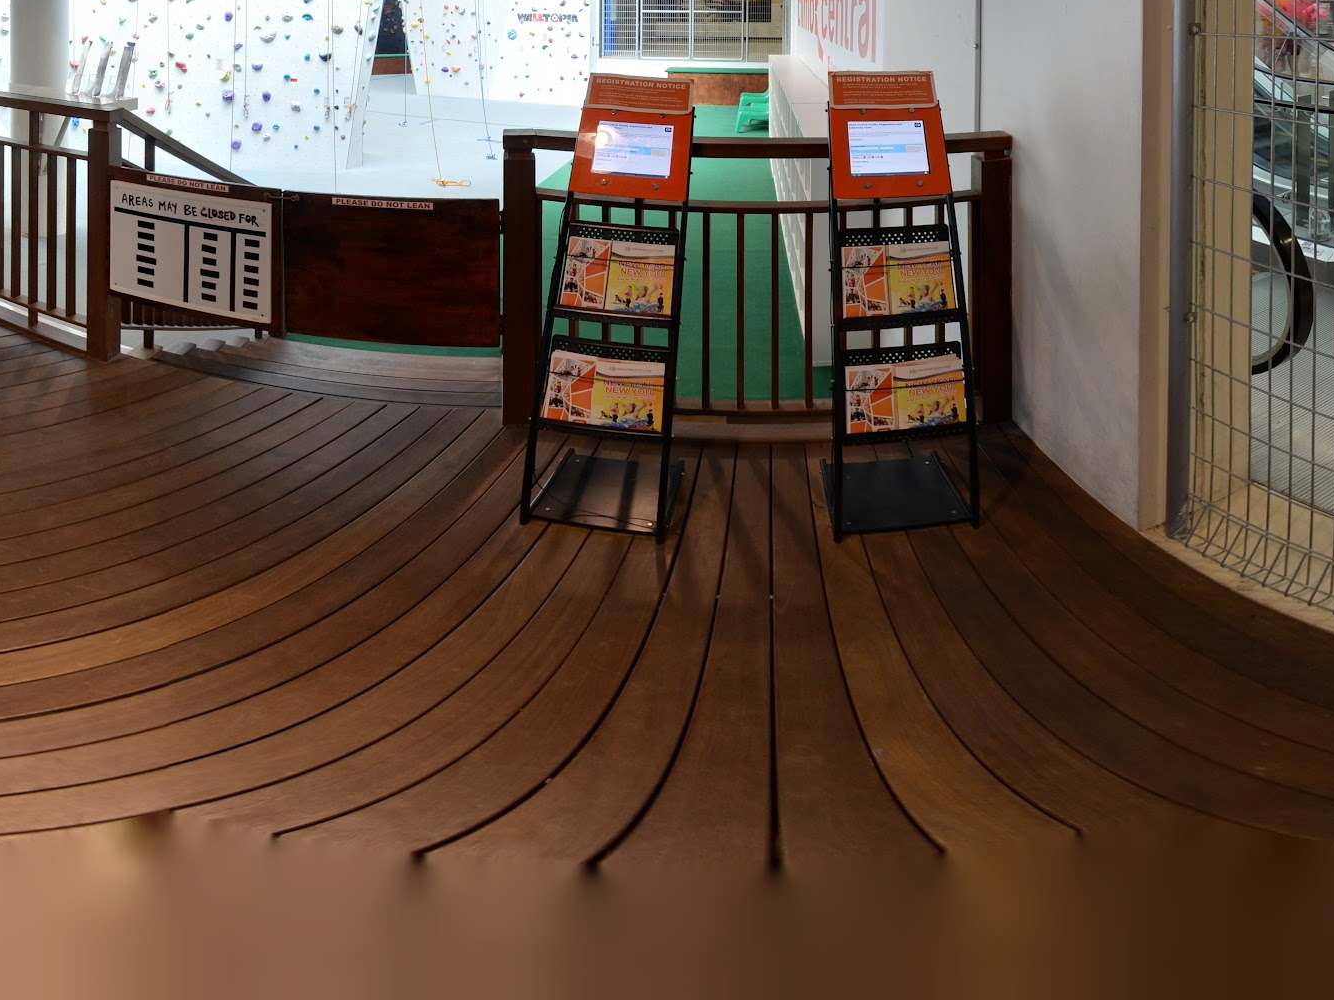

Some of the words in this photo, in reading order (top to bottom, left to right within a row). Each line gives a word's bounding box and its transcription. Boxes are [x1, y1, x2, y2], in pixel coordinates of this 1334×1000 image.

[596, 78, 654, 88] REGISTRATION
[656, 80, 686, 89] NOTICE
[150, 175, 175, 185] PLEASE
[206, 183, 226, 191] LEAN
[335, 198, 368, 206] PLEASE
[121, 193, 154, 207] AREAS
[158, 201, 178, 214] MAY
[184, 204, 197, 216] BE
[200, 206, 236, 221] CLOSED
[620, 267, 641, 276] NEW
[900, 269, 921, 277] NEW
[605, 386, 629, 394] NEW
[908, 387, 932, 396] NEW
